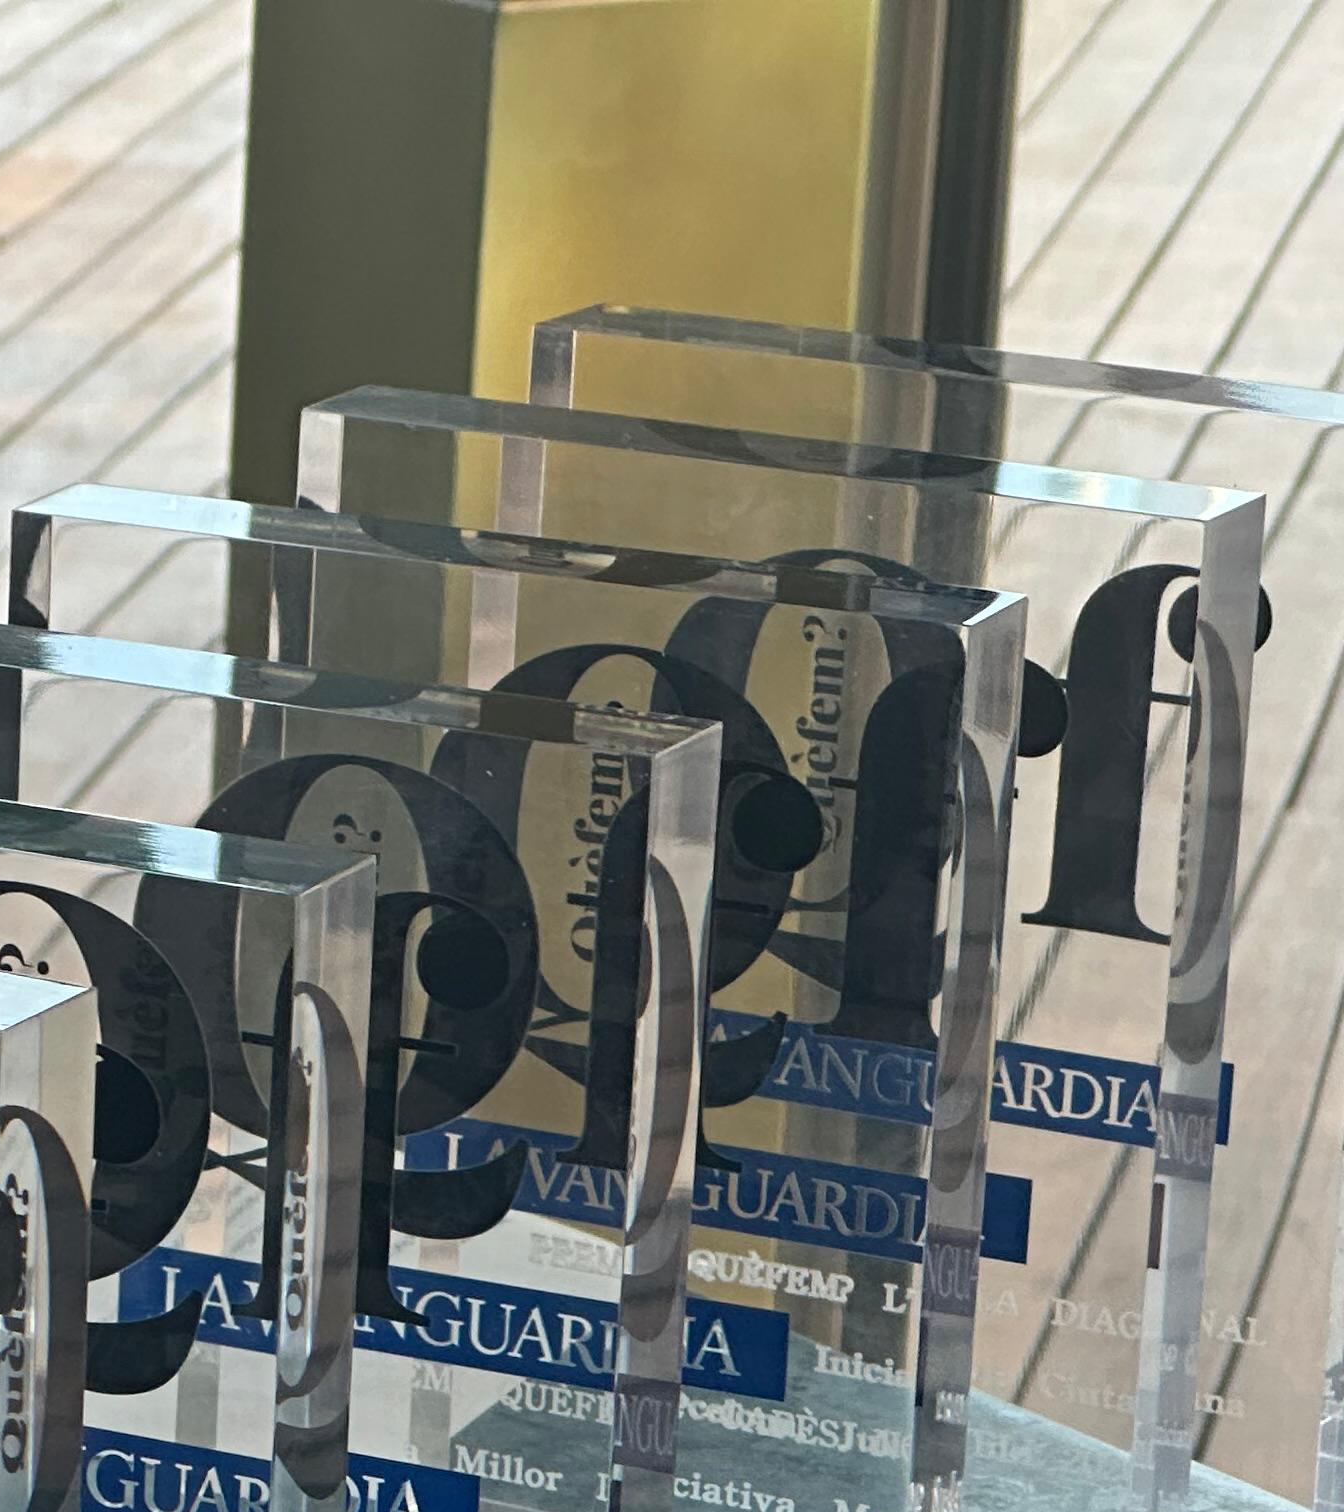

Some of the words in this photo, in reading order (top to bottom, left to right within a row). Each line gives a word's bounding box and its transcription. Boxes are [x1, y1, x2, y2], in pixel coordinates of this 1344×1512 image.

[687, 1250, 855, 1303] QUÈFEM?
[1051, 1298, 1267, 1347] DIAGNAL
[454, 1444, 564, 1492] Millor
